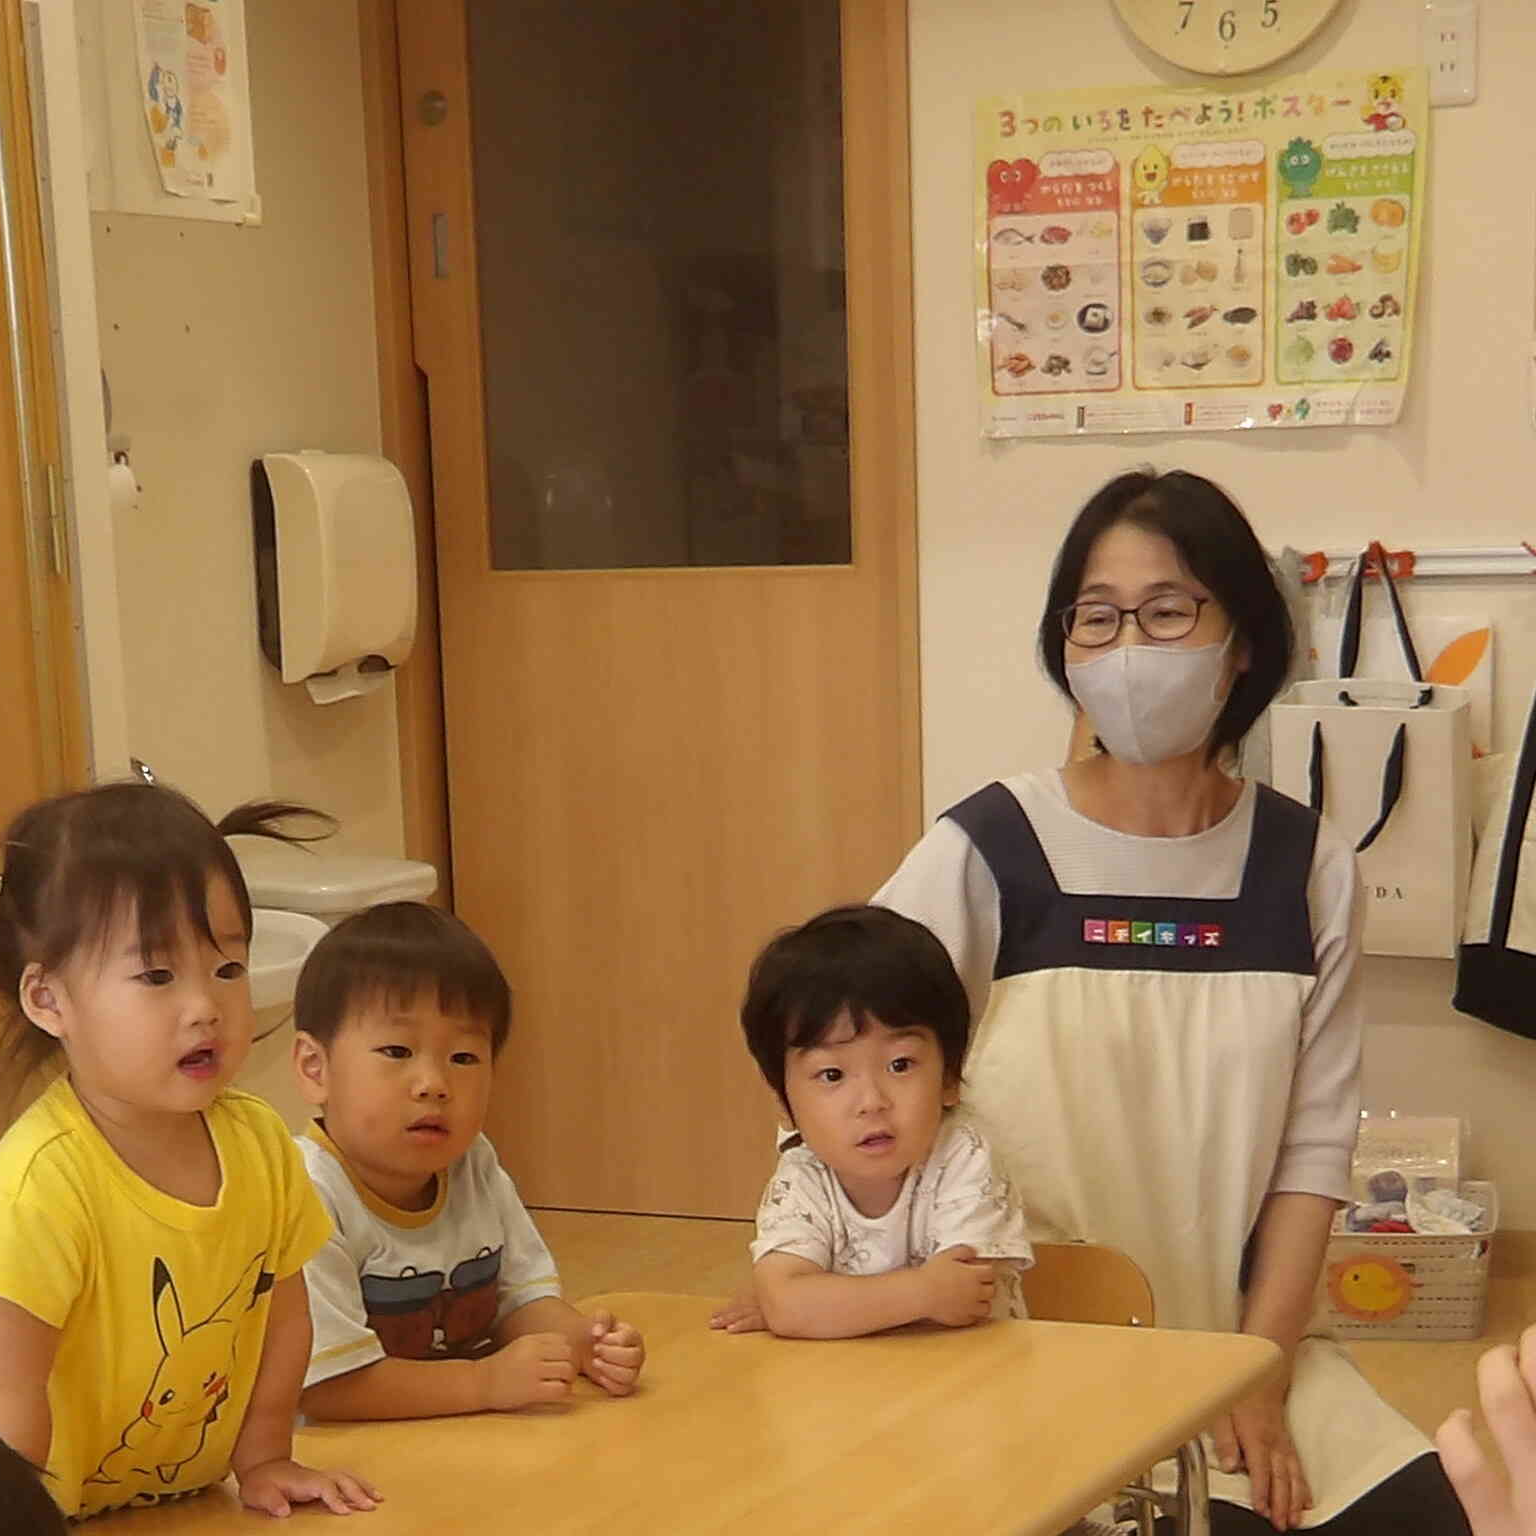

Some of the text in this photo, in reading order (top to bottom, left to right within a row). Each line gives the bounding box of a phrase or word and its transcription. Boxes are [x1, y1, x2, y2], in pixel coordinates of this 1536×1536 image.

[1177, 1, 1195, 30] 7
[1219, 10, 1236, 42] 6
[1261, 0, 1279, 28] 5
[1090, 925, 1222, 947] ニチイキッズ
